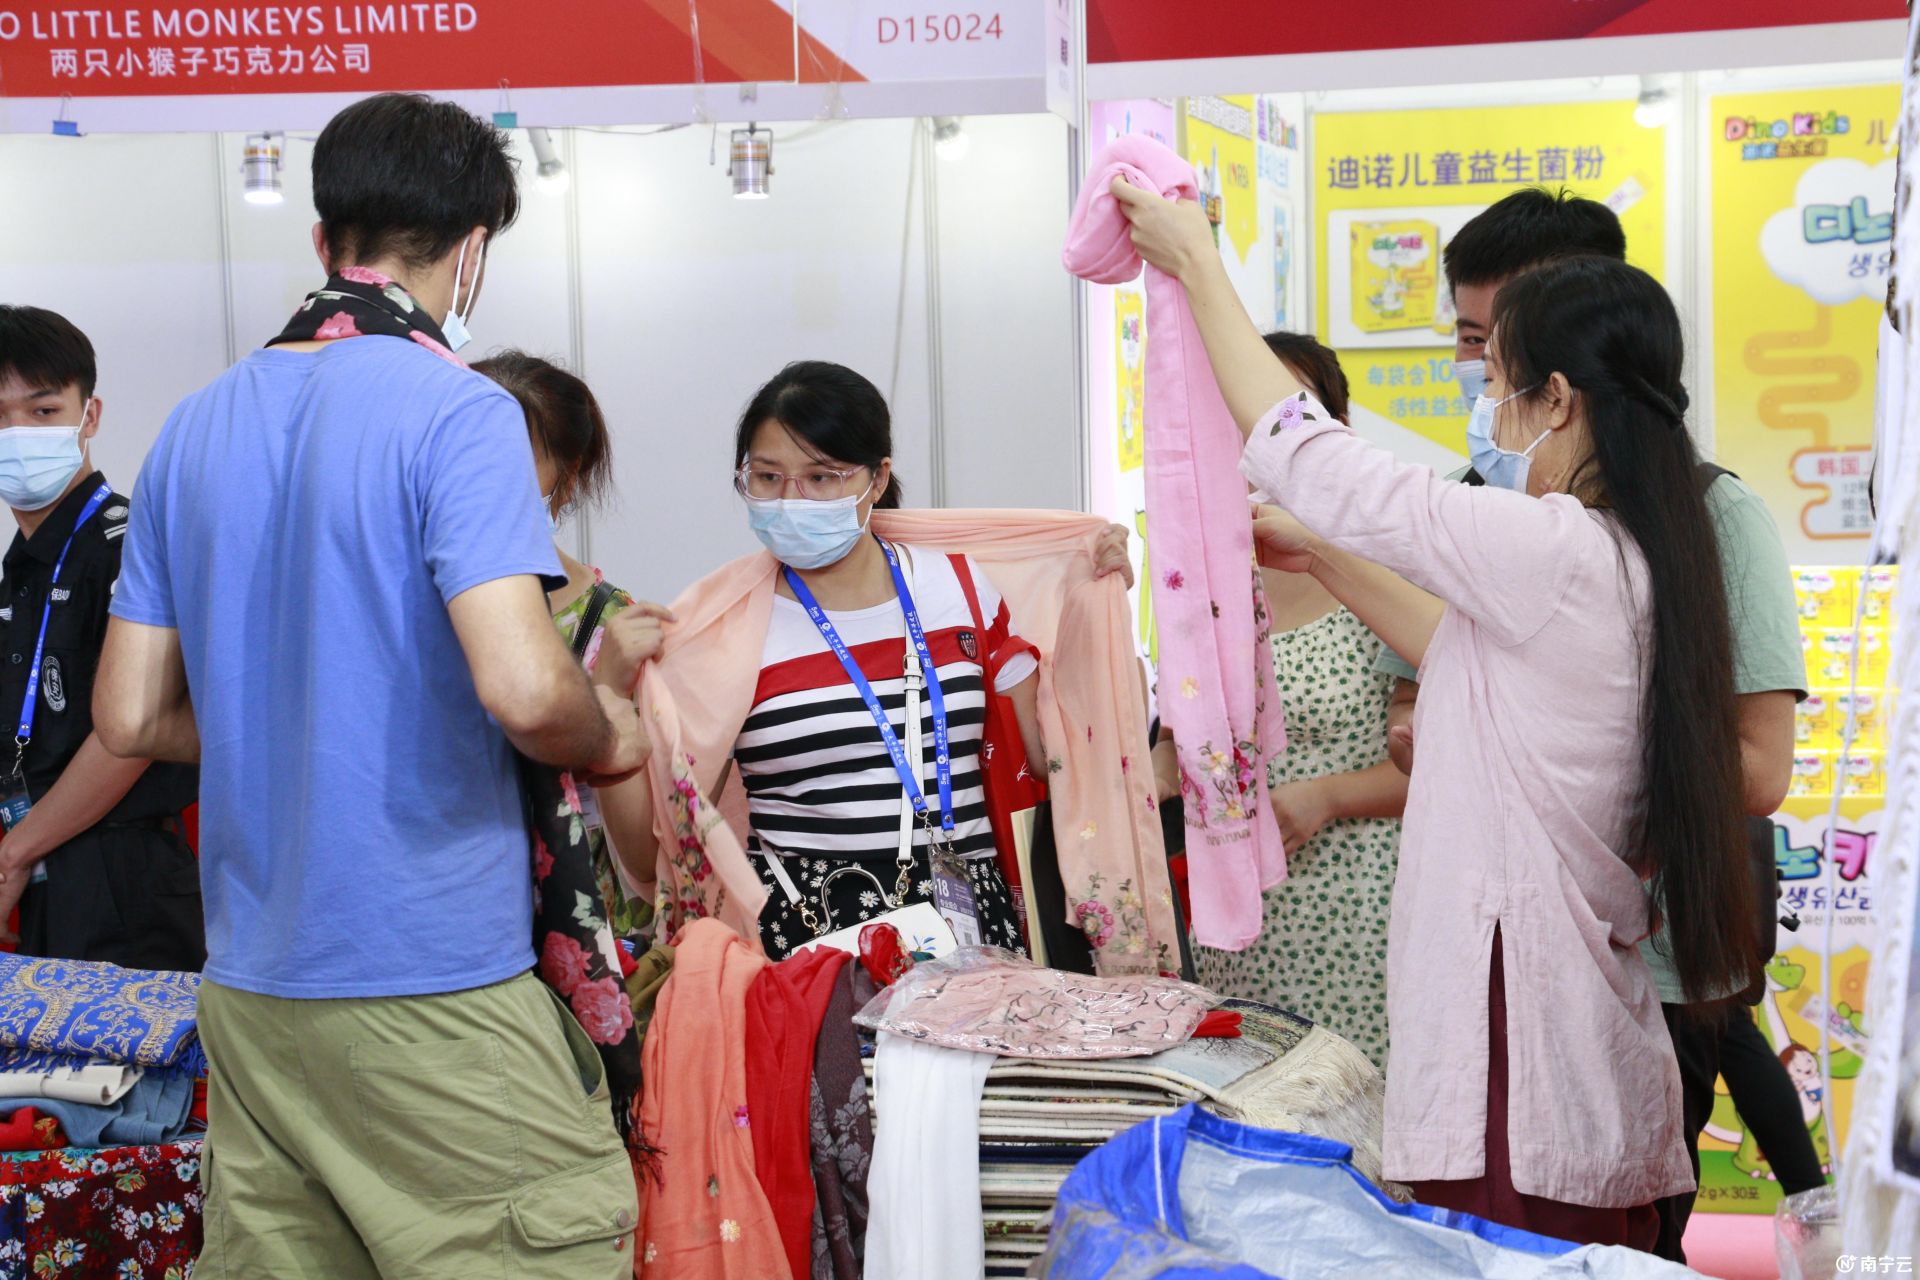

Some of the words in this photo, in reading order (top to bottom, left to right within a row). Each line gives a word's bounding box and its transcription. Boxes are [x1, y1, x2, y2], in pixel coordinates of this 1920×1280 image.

[32, 10, 141, 39] LITTLE
[152, 6, 324, 37] MONKEYS
[335, 3, 477, 34] LIMITED
[878, 13, 1003, 43] D15024
[50, 44, 371, 78] 两只小猴子巧克力公司
[1725, 116, 1789, 142] Dino
[1792, 110, 1849, 136] Kids
[1327, 145, 1606, 190] 迪诺儿童益生菌粉
[1803, 195, 1892, 244] 디노
[1367, 357, 1457, 387] 每袋含10
[936, 878, 950, 898] 18
